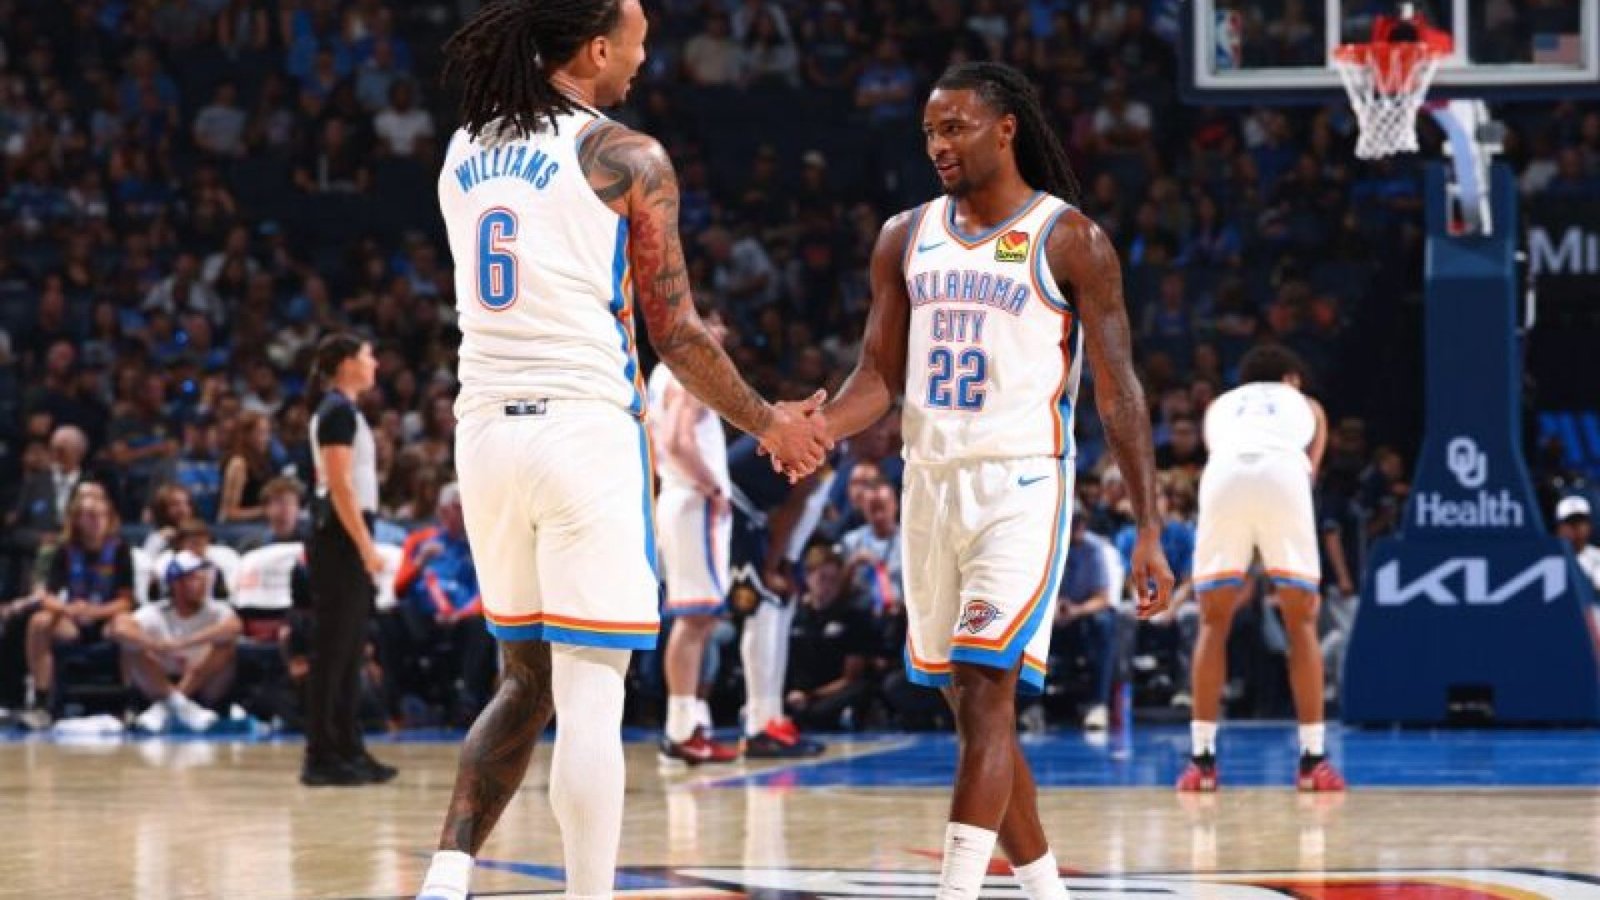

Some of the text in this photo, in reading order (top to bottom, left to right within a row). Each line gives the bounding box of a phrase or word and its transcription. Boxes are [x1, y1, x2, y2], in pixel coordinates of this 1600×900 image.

[455, 145, 559, 192] WILLIAMS
[476, 206, 519, 311] 6
[931, 308, 987, 343] CITY
[925, 345, 988, 411] 22
[1416, 489, 1524, 527] Health
[1376, 556, 1567, 605] KIA
